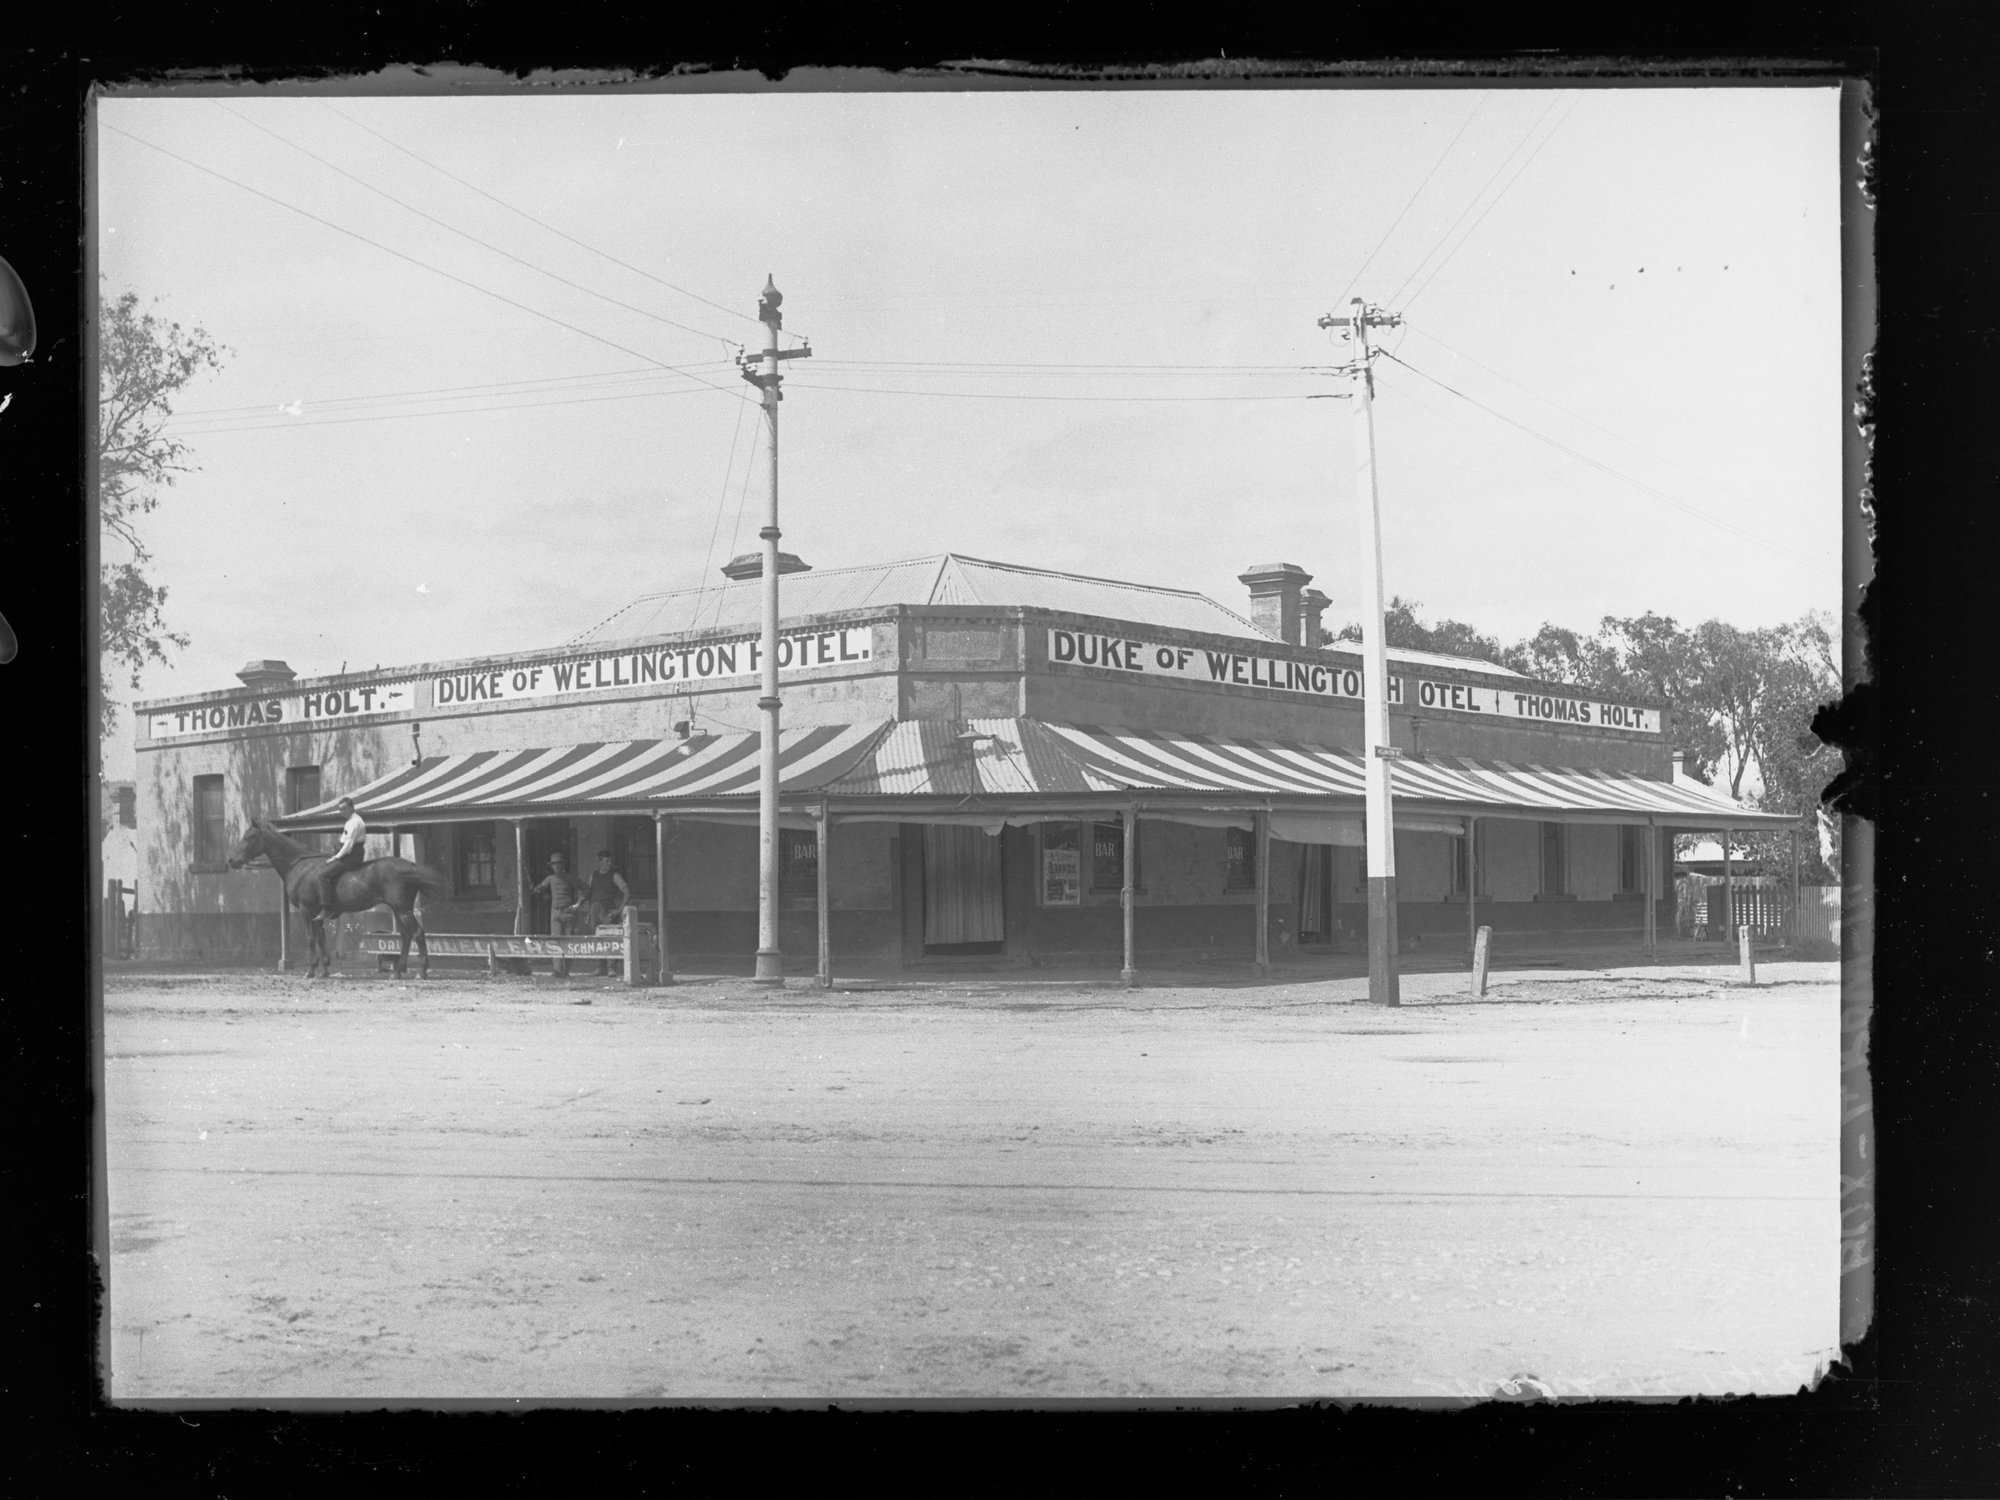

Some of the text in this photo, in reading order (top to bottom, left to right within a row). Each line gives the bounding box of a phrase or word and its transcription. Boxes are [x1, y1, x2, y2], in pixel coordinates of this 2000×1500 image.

[439, 631, 870, 704] DUKE OF WELLINGTON HOTEL.
[1054, 630, 1144, 671] DUKE
[1156, 647, 1194, 670] OF
[1206, 651, 1366, 698] WELLINGTO
[174, 687, 386, 733] THOMAS HOLT.
[1514, 694, 1649, 730] THOMAS HOLT.
[794, 844, 817, 859] BAR
[1095, 842, 1115, 857] BAR
[1227, 845, 1244, 860] BAR
